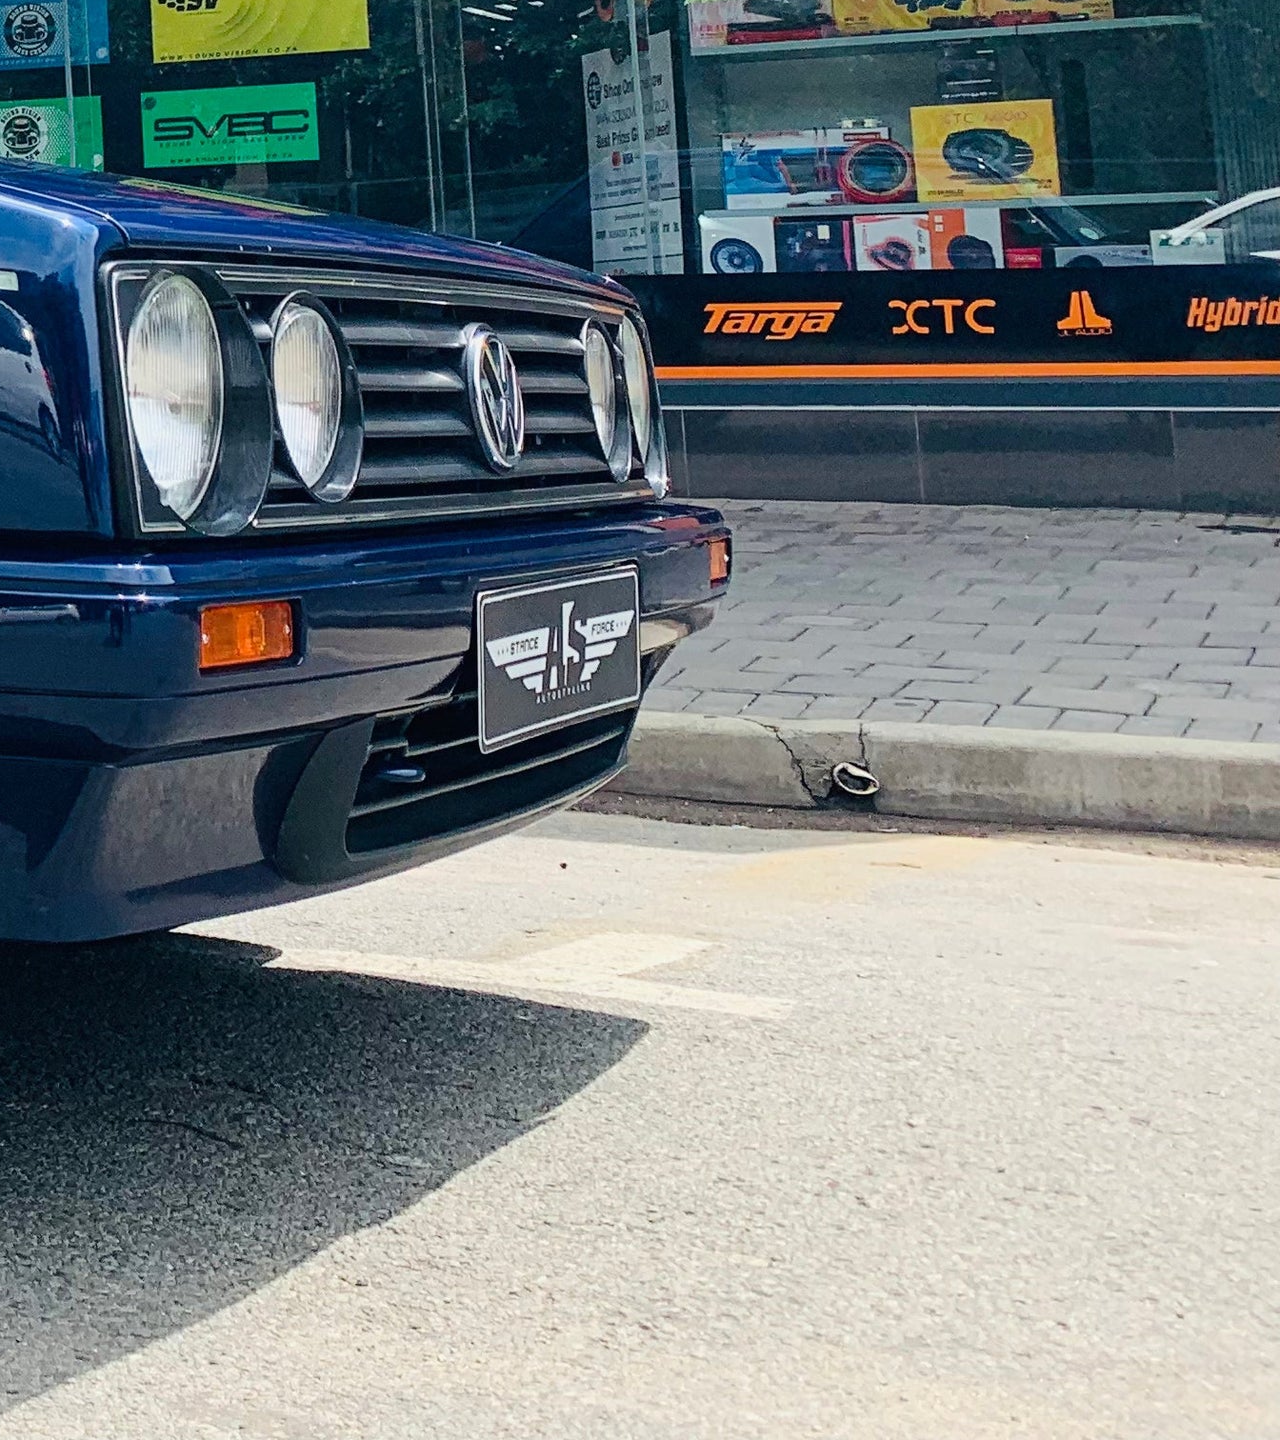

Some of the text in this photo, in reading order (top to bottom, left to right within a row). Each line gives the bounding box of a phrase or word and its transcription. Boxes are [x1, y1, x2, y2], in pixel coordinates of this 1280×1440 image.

[703, 301, 843, 341] Targa
[510, 620, 615, 656] STANCE FORCE
